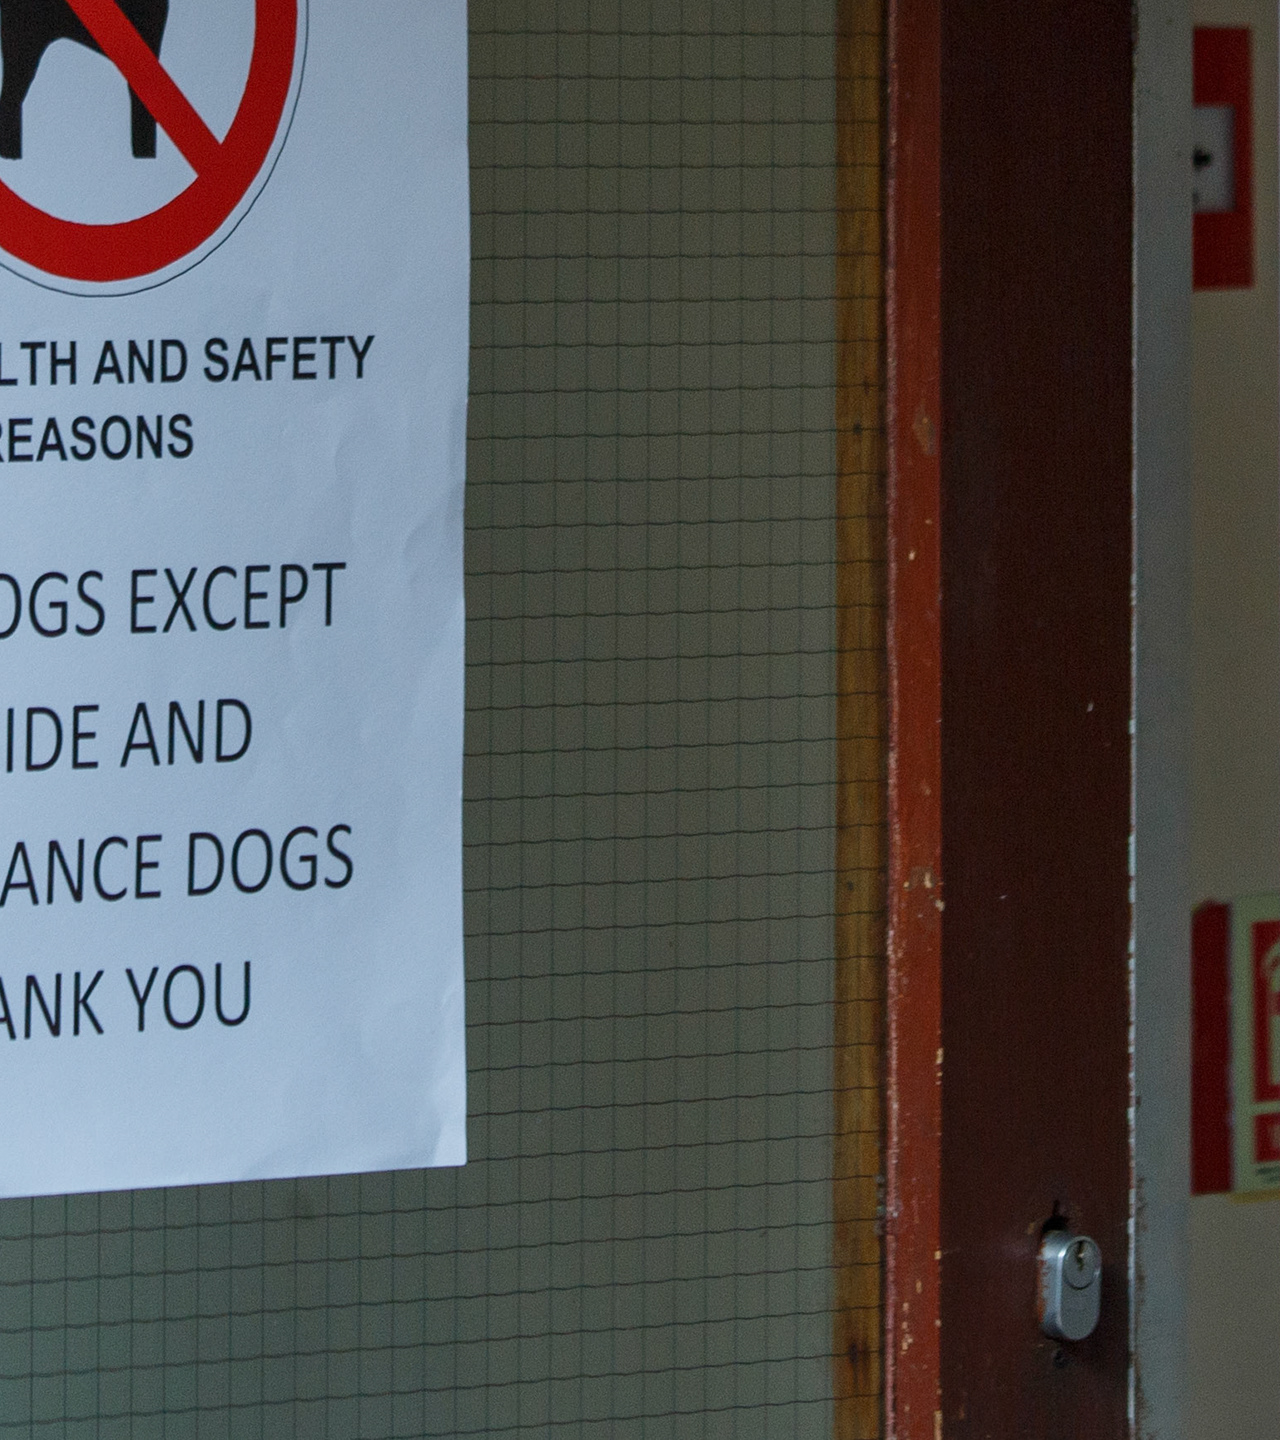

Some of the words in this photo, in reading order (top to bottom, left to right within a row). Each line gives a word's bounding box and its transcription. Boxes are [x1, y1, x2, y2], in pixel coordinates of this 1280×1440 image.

[93, 338, 188, 385] AND
[203, 334, 376, 383] SAFETY
[130, 561, 347, 635] EXCEPT
[120, 698, 252, 768] AND
[187, 823, 354, 898] DOGS
[125, 961, 252, 1033] YOU
